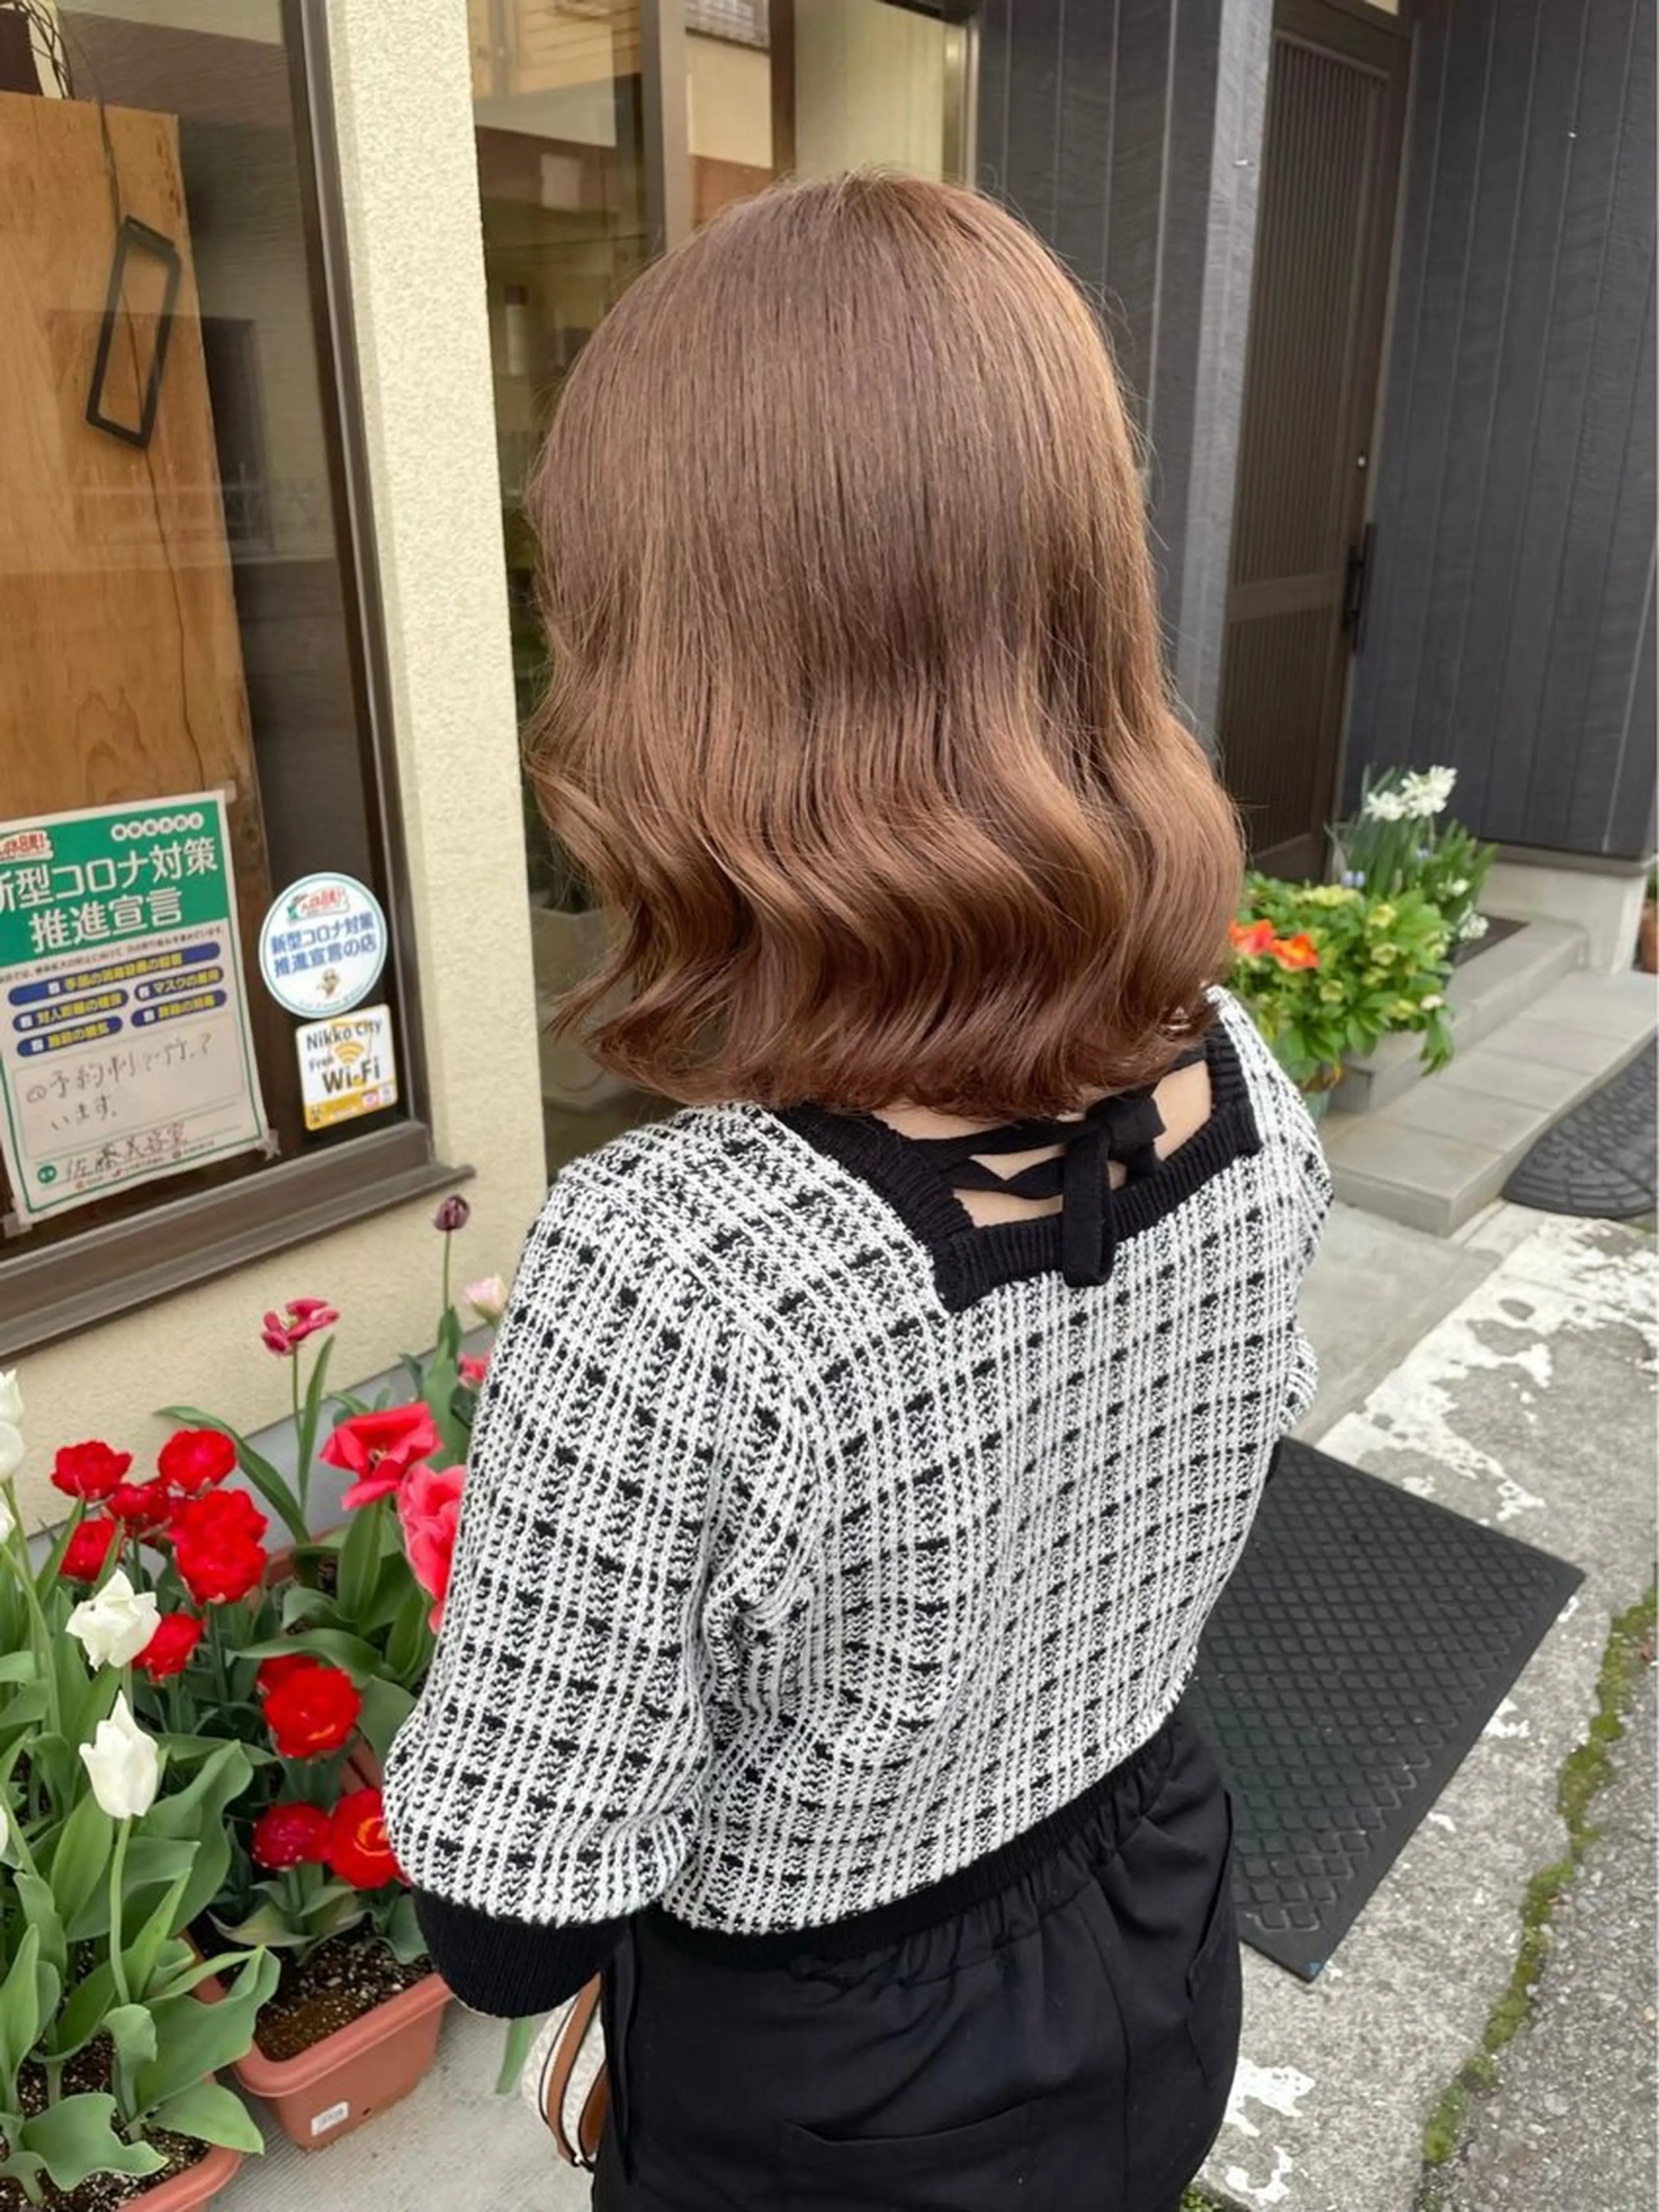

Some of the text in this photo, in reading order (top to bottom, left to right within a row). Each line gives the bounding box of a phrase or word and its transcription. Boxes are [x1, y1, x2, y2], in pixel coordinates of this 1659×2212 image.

[29, 887, 182, 953] 推進宣言
[270, 911, 374, 954] 新型コロナ対策
[274, 933, 376, 979] 推進宣言の店
[306, 1016, 382, 1057] Nikko City
[308, 1055, 334, 1073] Free
[321, 1055, 380, 1094] Wi-Fi
